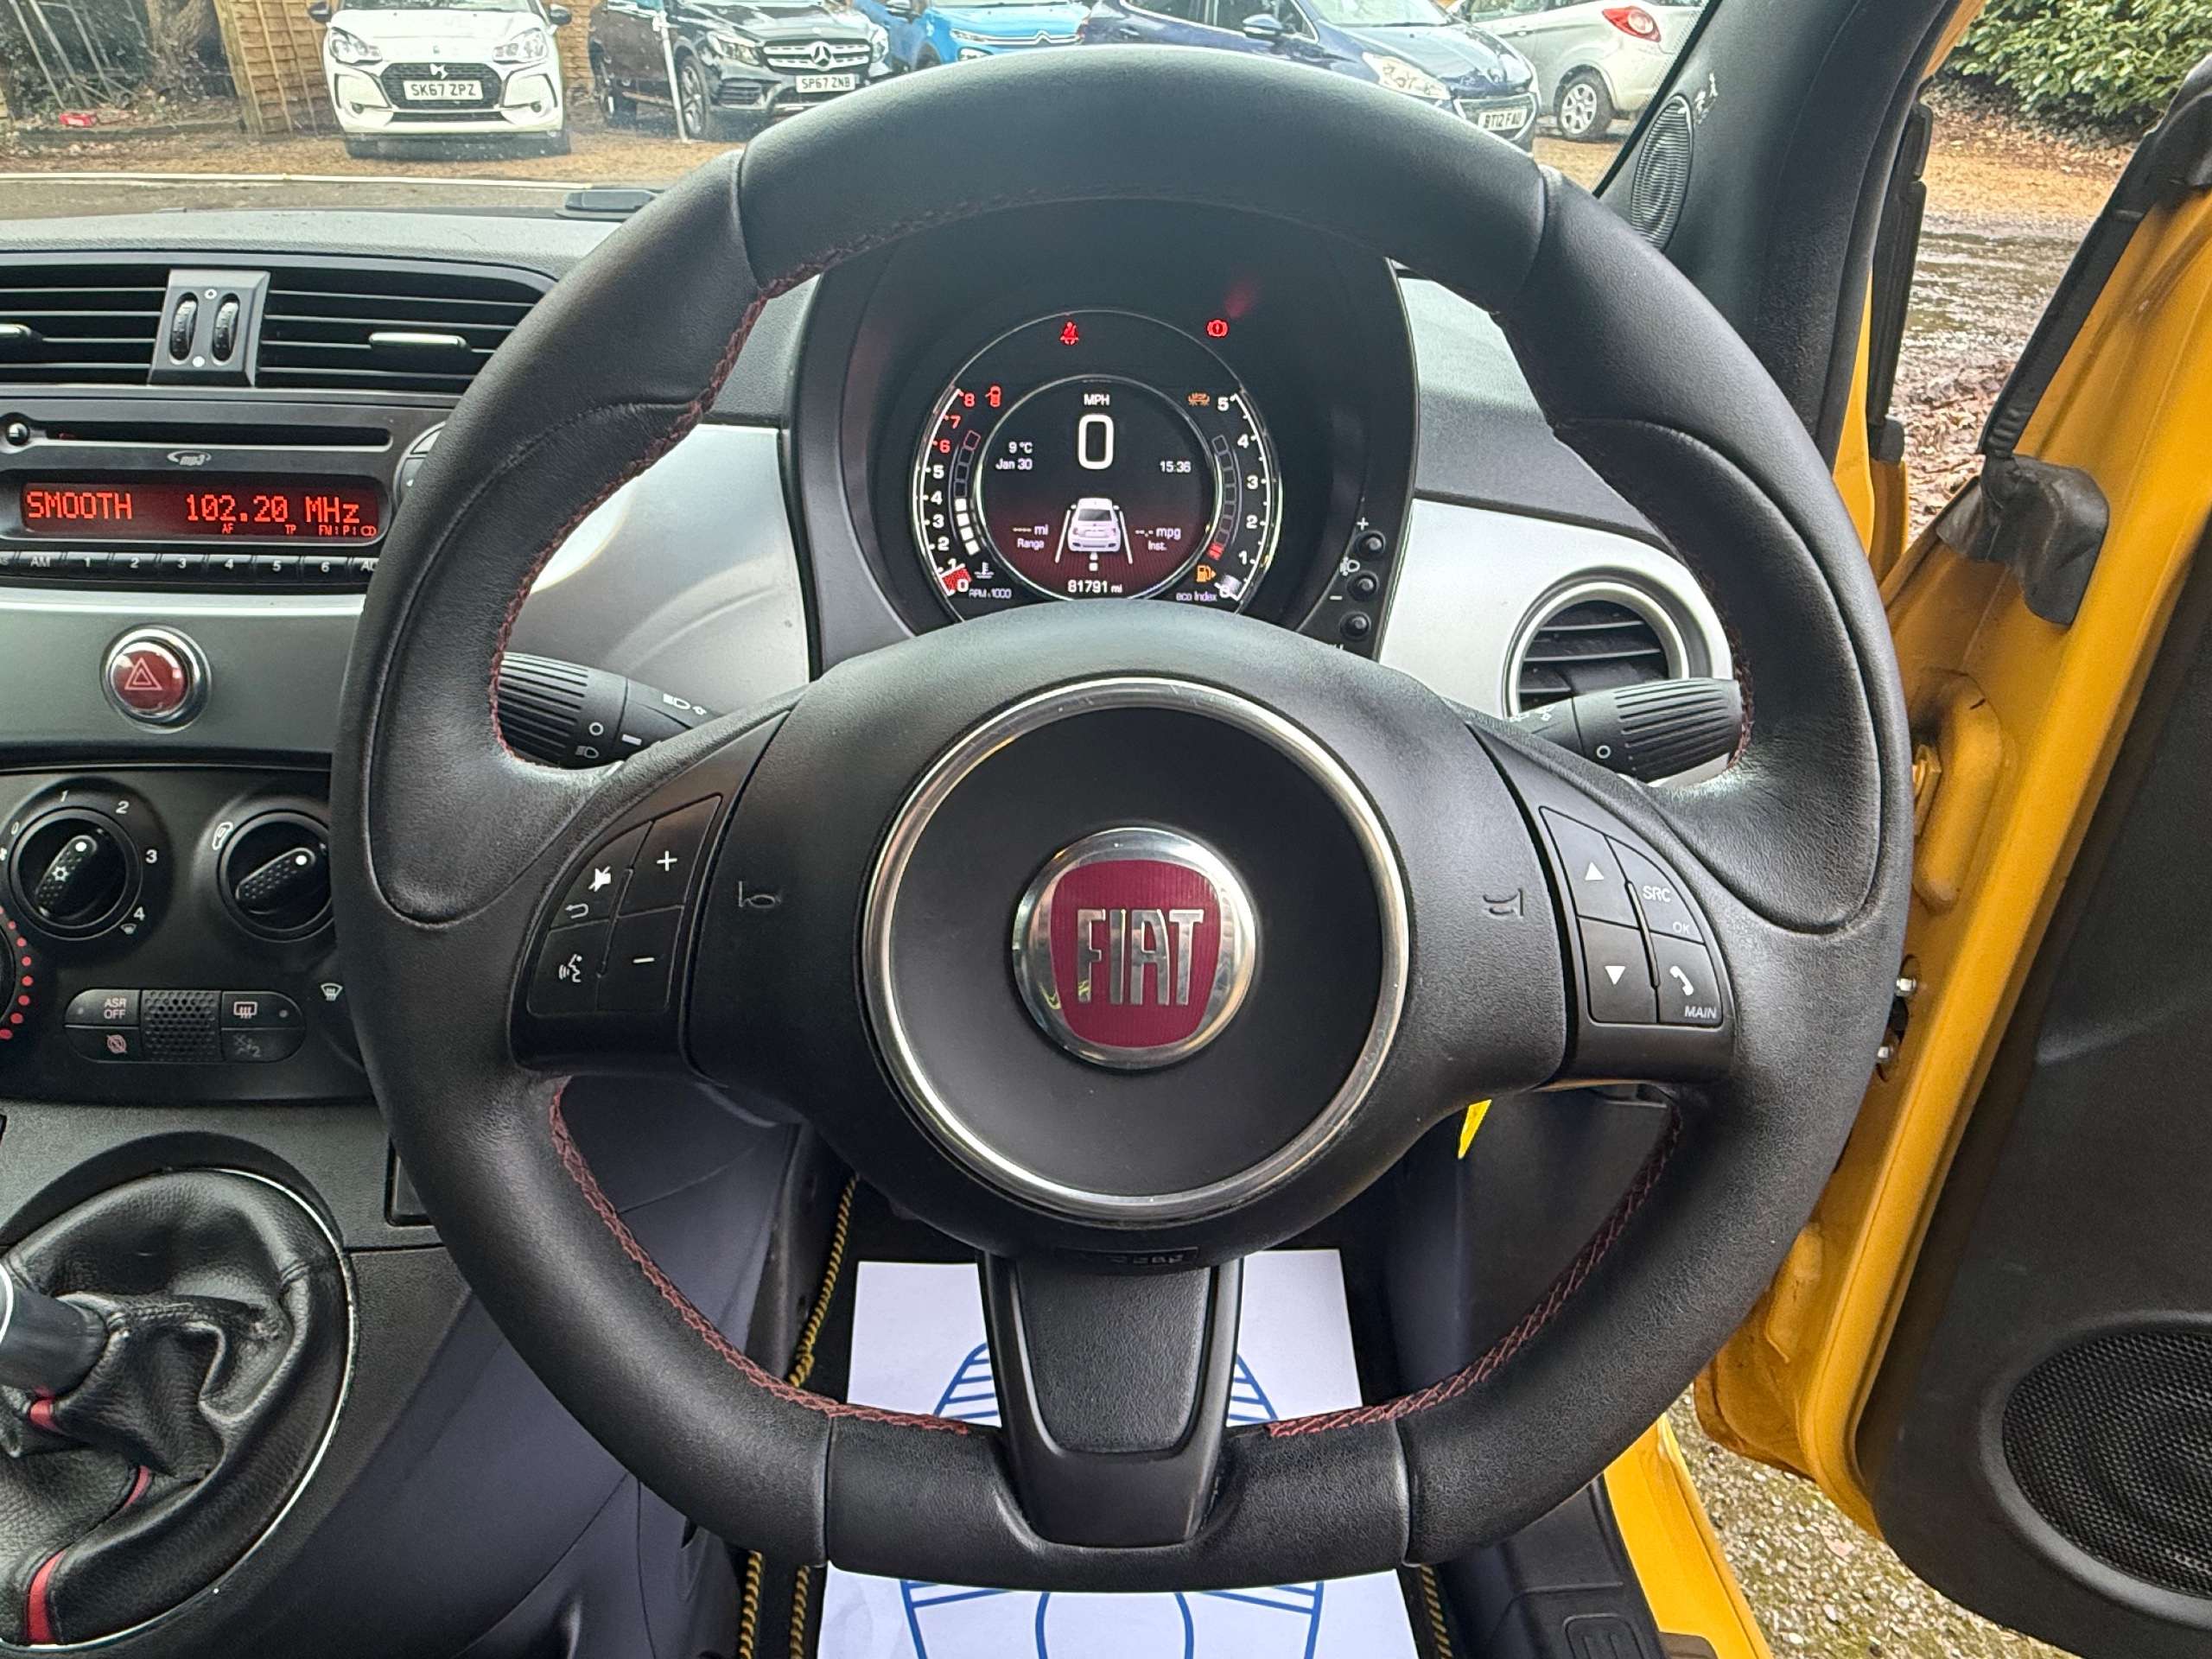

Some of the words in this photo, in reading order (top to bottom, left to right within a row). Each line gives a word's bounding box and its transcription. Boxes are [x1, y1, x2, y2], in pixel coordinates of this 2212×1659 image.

[801, 78, 829, 89] SP67
[831, 76, 850, 87] ZNB
[410, 84, 445, 97] SK67
[448, 83, 476, 97] ZPZ
[964, 392, 976, 407] 8
[1084, 394, 1110, 406] MPH
[1217, 397, 1229, 411] 5
[950, 415, 962, 429] 7
[939, 439, 951, 454] 6
[1008, 441, 1018, 454] 9
[1077, 413, 1115, 471] 0
[1236, 434, 1249, 448] 4
[995, 458, 1015, 470] Jan
[1017, 458, 1033, 470] 30
[1160, 461, 1192, 474] 15:36
[932, 464, 945, 480] 5
[1246, 474, 1259, 490] 3
[931, 490, 943, 505] 4
[27, 491, 133, 520] SMOOTH
[186, 493, 289, 524] 102.20
[304, 496, 360, 524] MHz
[932, 513, 945, 529] 3
[1246, 514, 1258, 529] 2
[1155, 527, 1182, 541] mpg
[937, 536, 950, 551] 2
[1017, 537, 1045, 551] Range
[29, 556, 51, 568] AM
[84, 557, 91, 567] 1
[131, 558, 139, 569] 2
[178, 558, 187, 569] 3
[225, 558, 234, 569] 4
[272, 560, 282, 572] 5
[321, 561, 330, 573] 6
[1238, 550, 1248, 565] 1
[957, 578, 969, 593] 0
[1067, 579, 1109, 594] 81791
[1110, 583, 1122, 594] mi
[1176, 592, 1192, 601] eco
[60, 790, 68, 802] 1
[116, 800, 129, 814] 2
[10, 821, 19, 835] 0
[145, 849, 157, 863] 3
[1643, 885, 1671, 903] SRC
[133, 906, 145, 920] 4
[1672, 921, 1690, 935] OK
[1077, 909, 1205, 1006] FIAT
[104, 997, 127, 1008] ASR
[104, 1008, 126, 1020] OFF
[1684, 1005, 1717, 1019] MAIN
